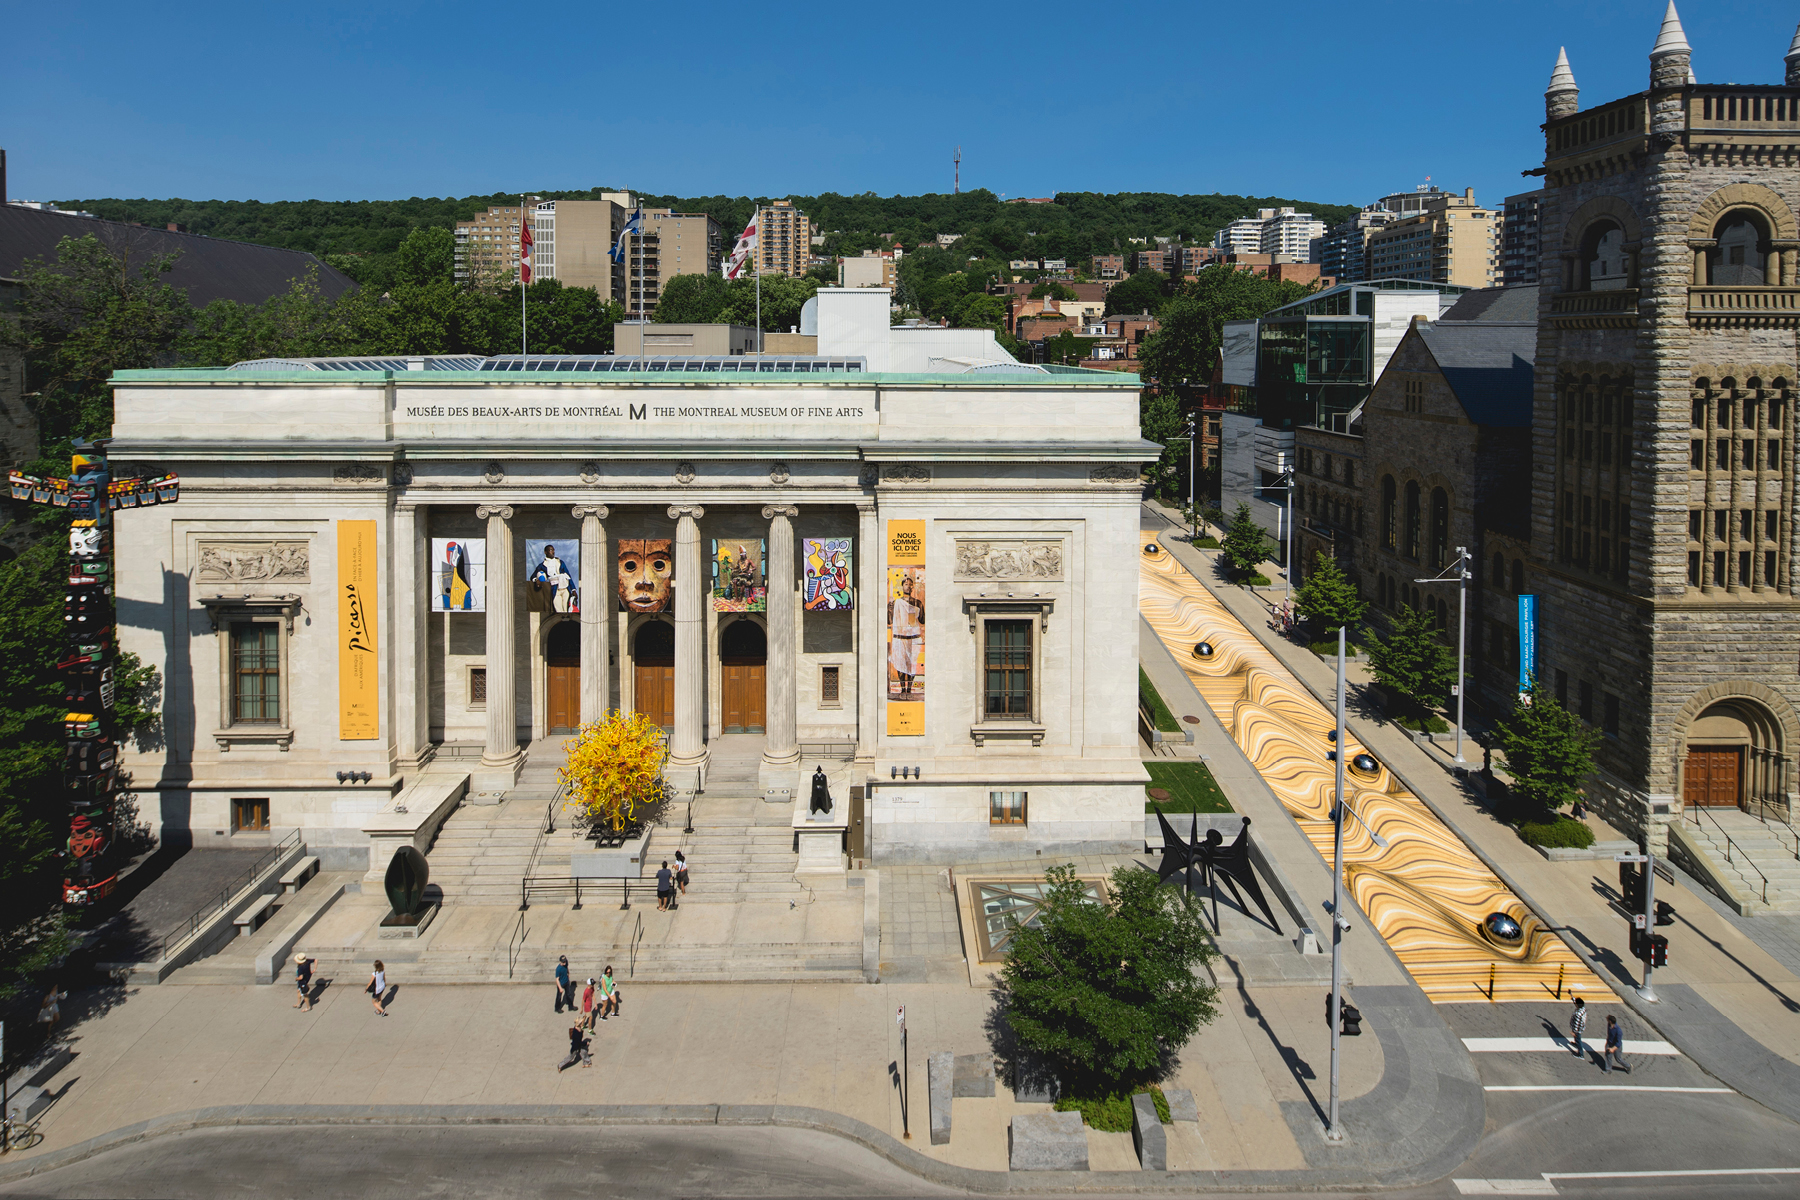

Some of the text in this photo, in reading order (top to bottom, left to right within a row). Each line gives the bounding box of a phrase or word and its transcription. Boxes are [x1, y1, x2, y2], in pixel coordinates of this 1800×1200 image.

[407, 405, 623, 417] MUSÉE DES BEAUX-ARTS DE MONTRÉAL
[629, 403, 647, 420] M
[653, 407, 864, 417] THE MONTREAL MUSEUM OF FINE ARTS
